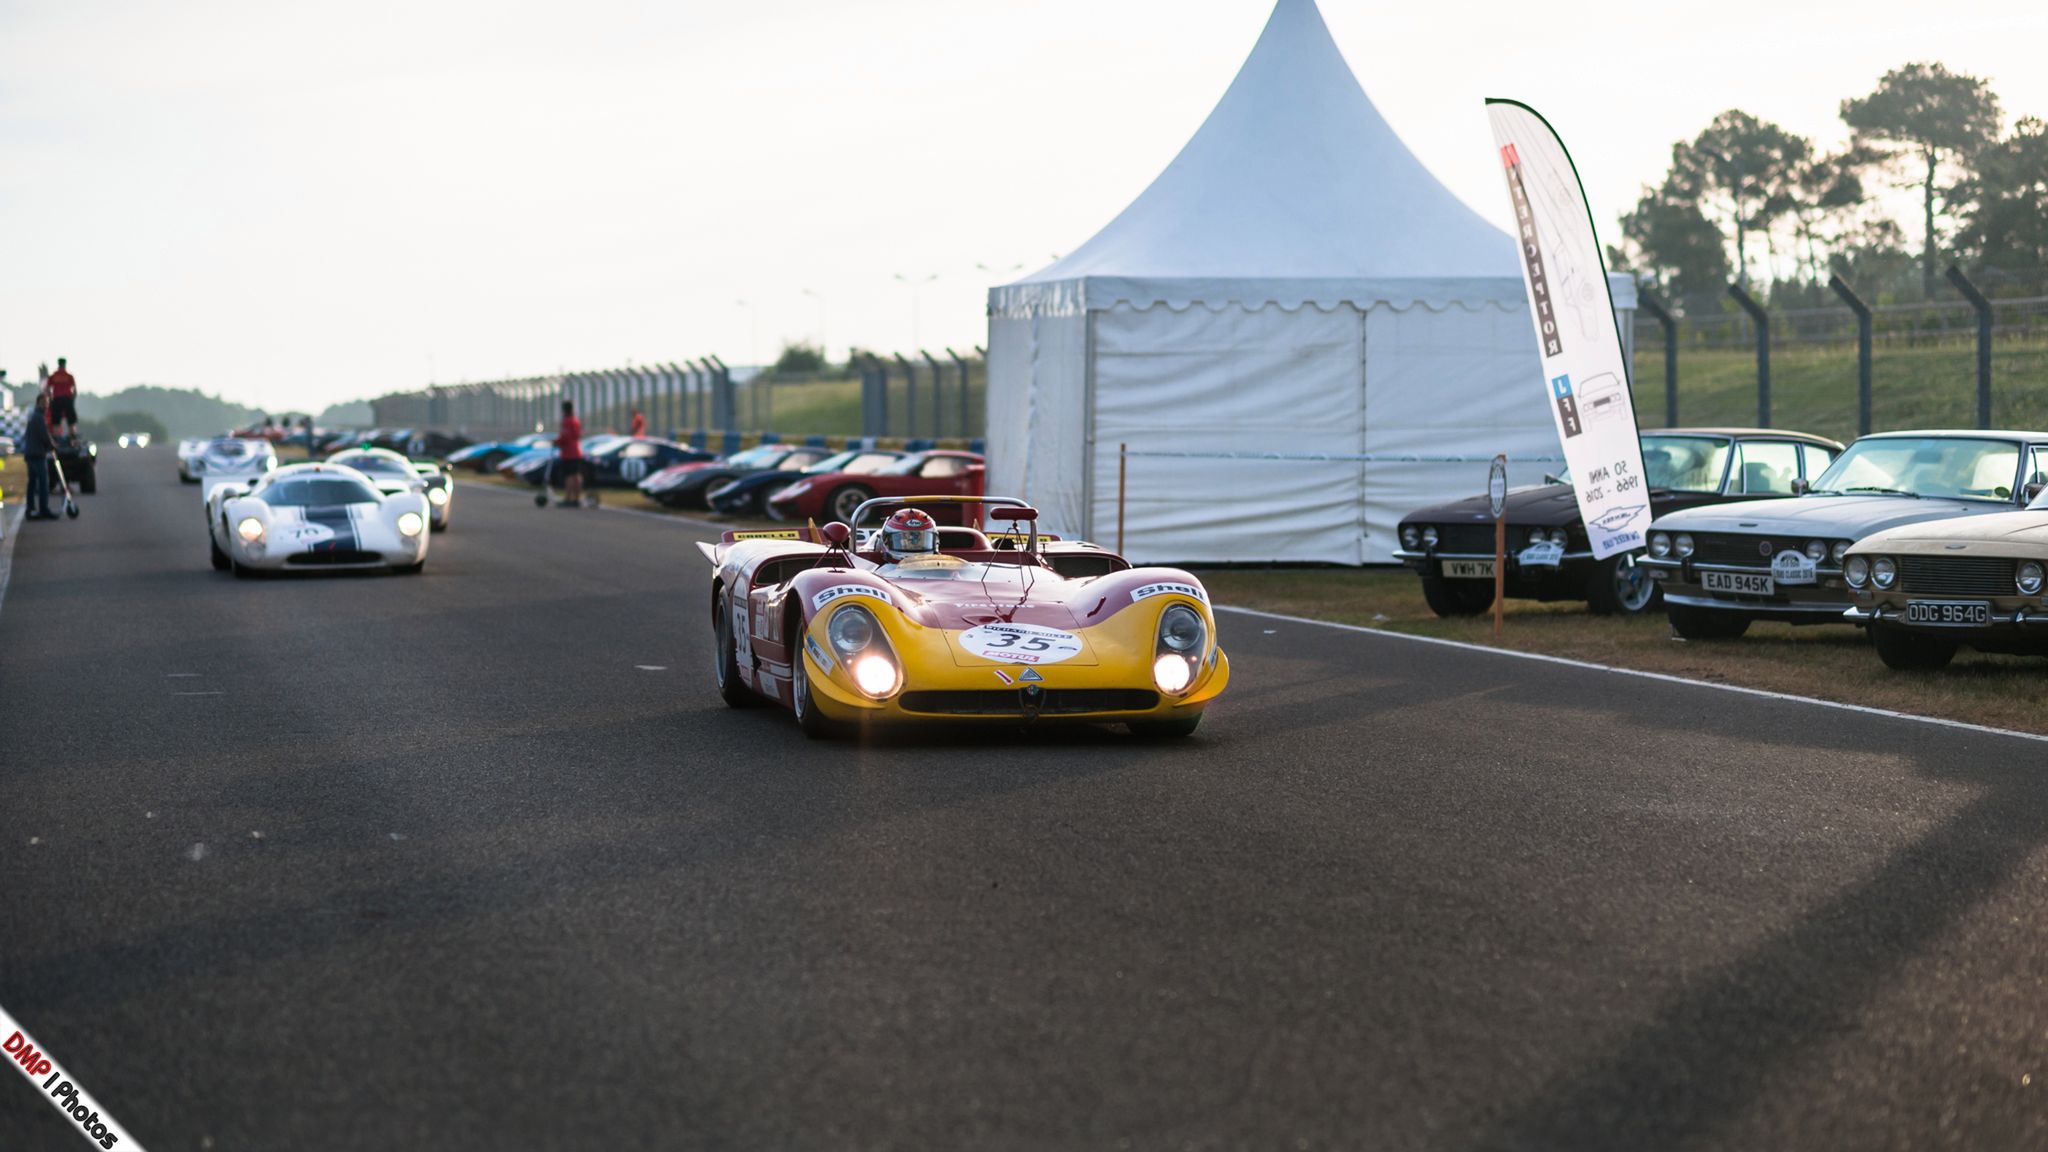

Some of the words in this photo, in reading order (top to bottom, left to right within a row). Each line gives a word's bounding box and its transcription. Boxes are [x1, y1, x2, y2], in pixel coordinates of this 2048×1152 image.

[1451, 562, 1476, 575] VWH
[1479, 562, 1495, 576] 7K
[1706, 573, 1733, 590] EAD
[1734, 575, 1769, 593] 945K
[818, 586, 888, 604] Shell
[1136, 584, 1204, 601] Shell
[1908, 604, 1939, 621] ODG
[1942, 605, 1986, 622] 964G
[986, 633, 1056, 651] 35
